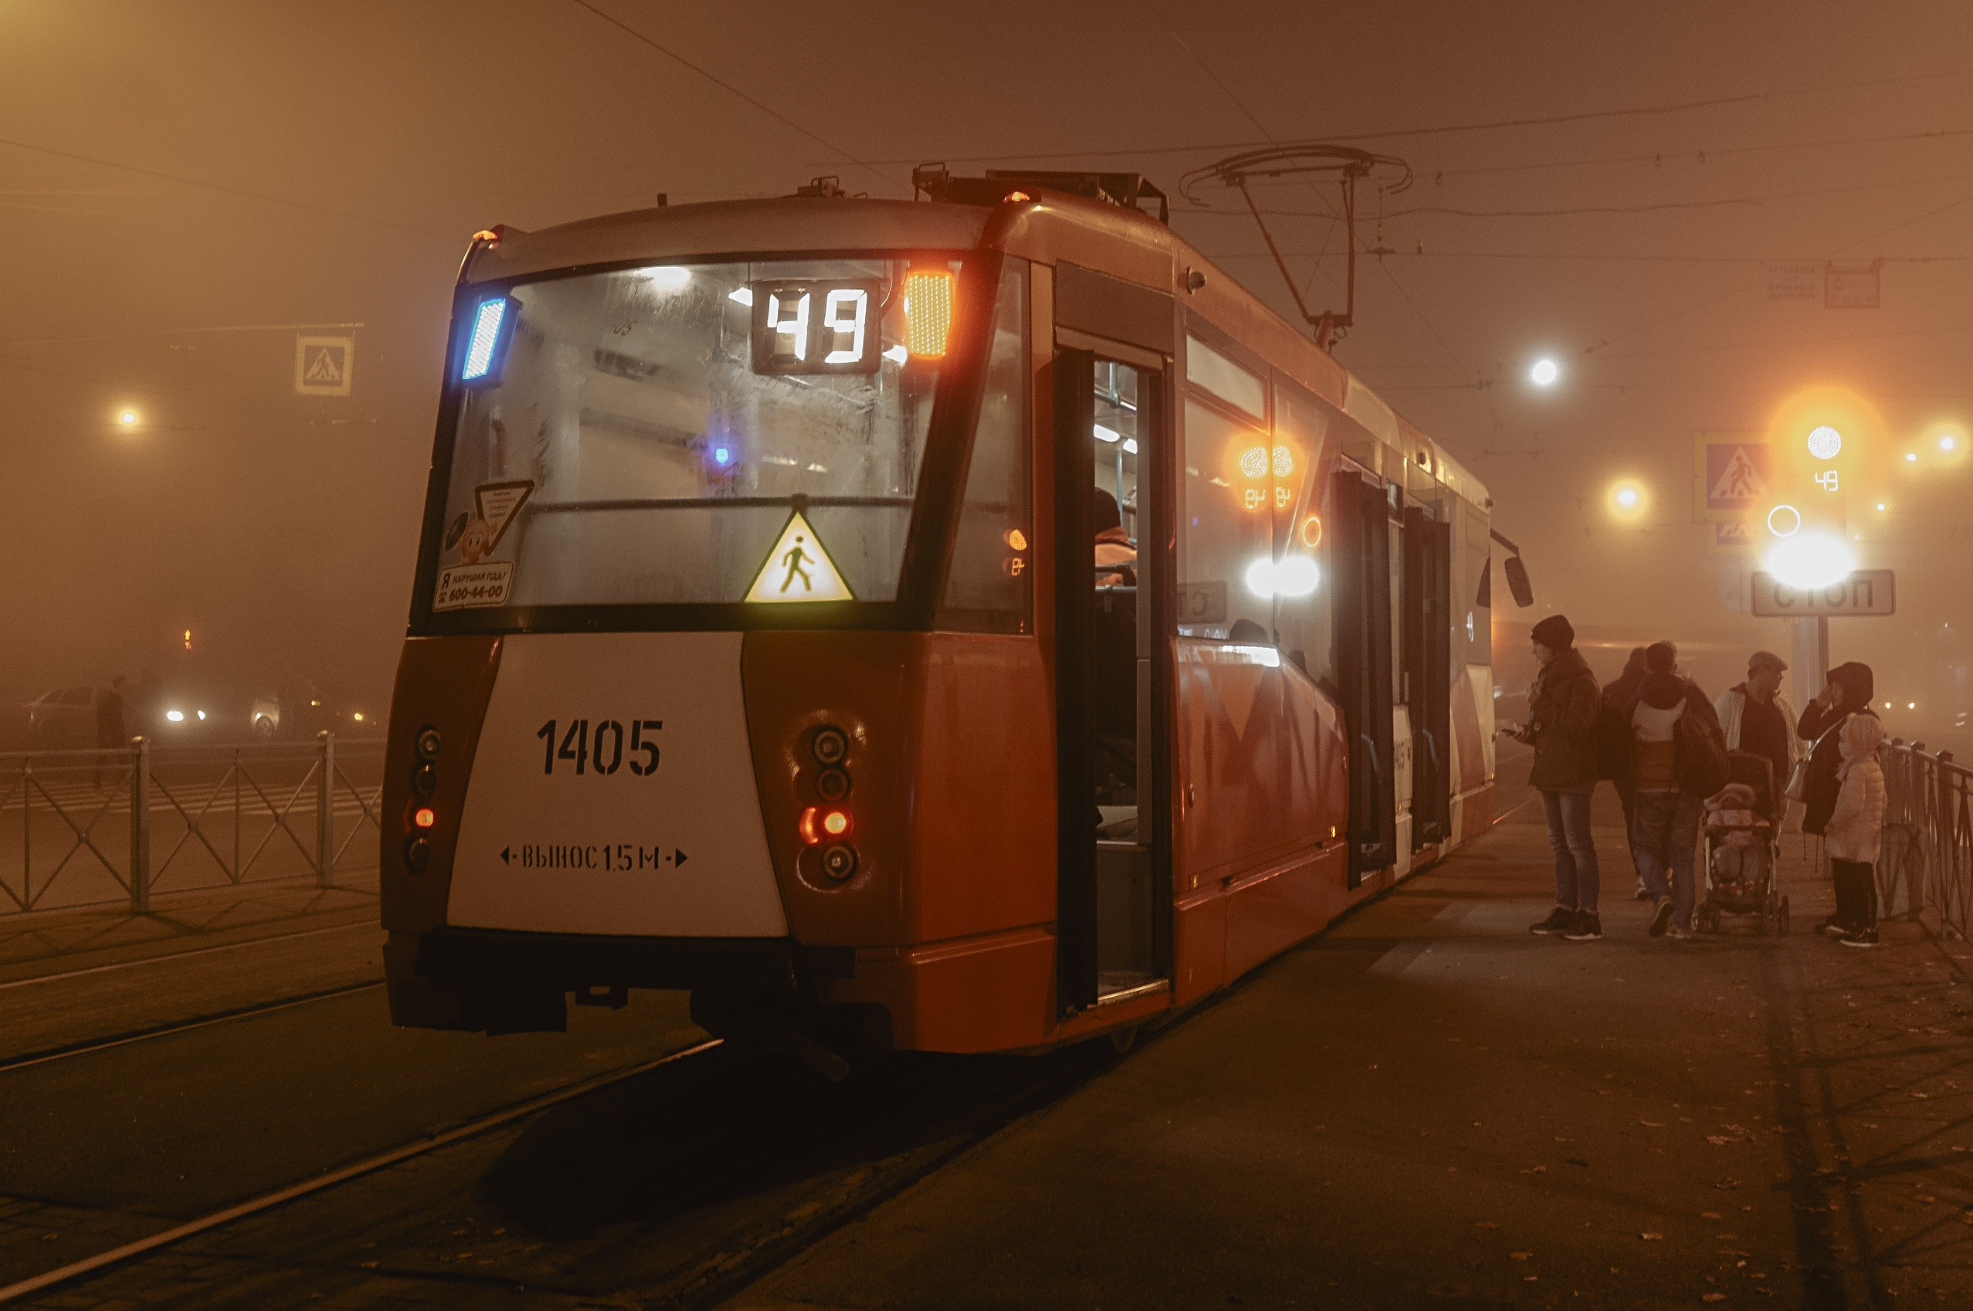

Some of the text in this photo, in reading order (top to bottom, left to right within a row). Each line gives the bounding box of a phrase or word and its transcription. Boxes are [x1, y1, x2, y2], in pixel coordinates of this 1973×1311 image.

[766, 289, 868, 363] 49
[1815, 470, 1838, 492] 49
[441, 573, 451, 589] Я
[449, 585, 503, 602] 600-44-00
[537, 719, 663, 776] 1405
[523, 845, 597, 868] ВЫНОС
[639, 846, 659, 869] М
